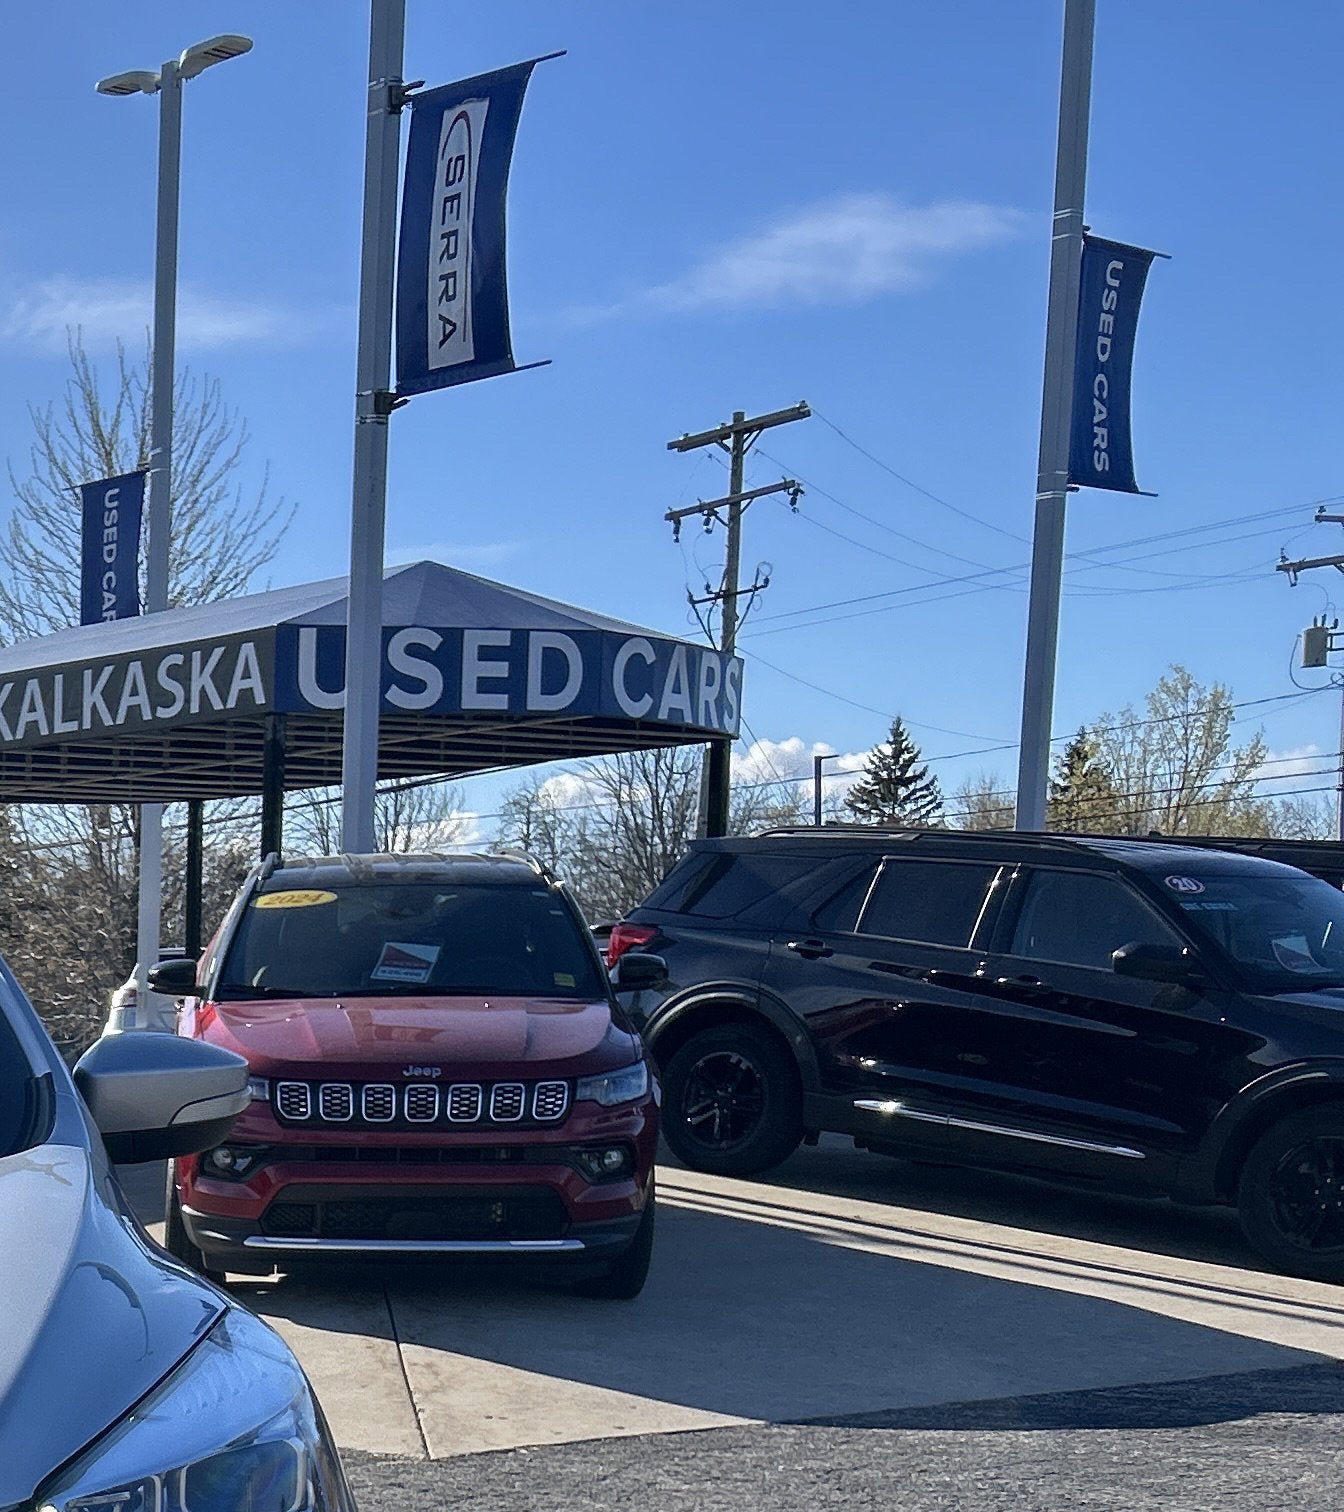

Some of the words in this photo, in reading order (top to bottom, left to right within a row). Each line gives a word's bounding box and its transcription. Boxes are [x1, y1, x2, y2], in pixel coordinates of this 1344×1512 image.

[437, 153, 466, 350] SERRA
[1096, 260, 1124, 363] USED
[1093, 373, 1110, 473] CARS
[102, 487, 120, 564] USED
[297, 627, 584, 711] USED
[612, 636, 741, 735] CARS
[1172, 876, 1198, 891] 20
[402, 1064, 442, 1079] Jeep
